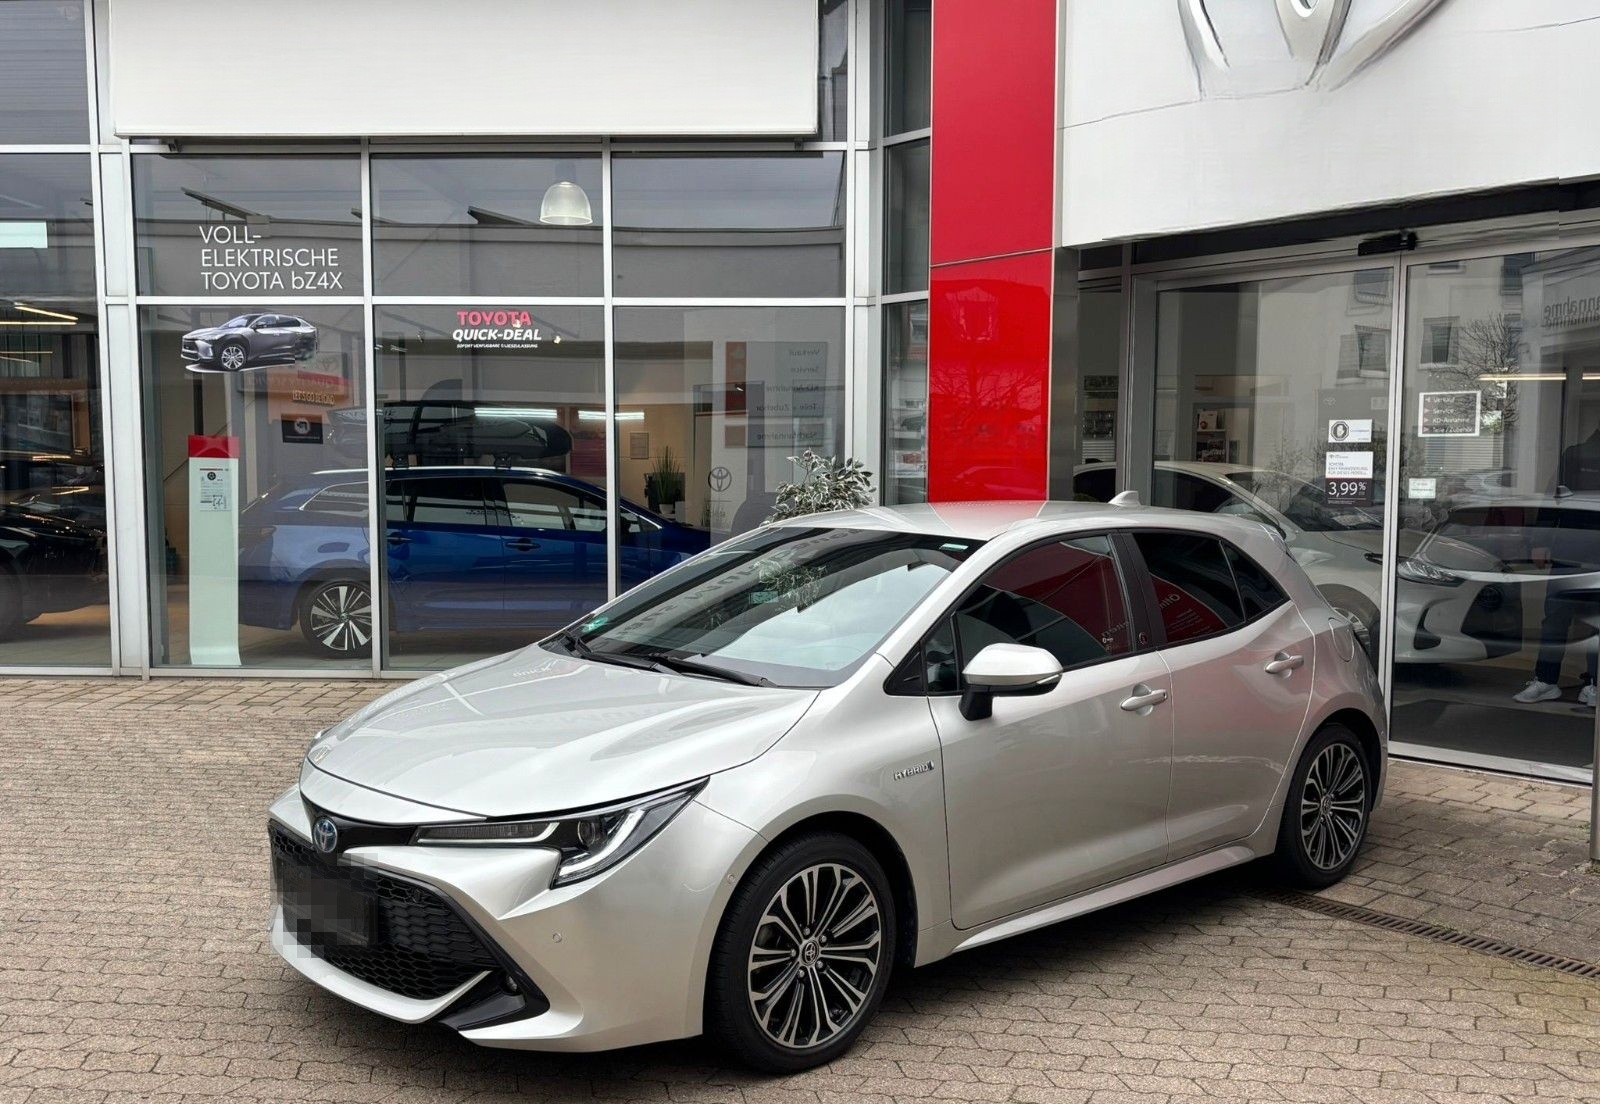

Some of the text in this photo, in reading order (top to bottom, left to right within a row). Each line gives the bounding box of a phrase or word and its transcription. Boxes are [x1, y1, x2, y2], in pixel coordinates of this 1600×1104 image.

[199, 226, 262, 244] VOLL-
[201, 248, 339, 267] ELEKTRISCHE
[201, 271, 343, 290] TOYOTA bZ4X
[457, 311, 532, 326] TOYOTA
[452, 328, 542, 342] QUICK-DEAL
[893, 764, 929, 781] HYBRID
